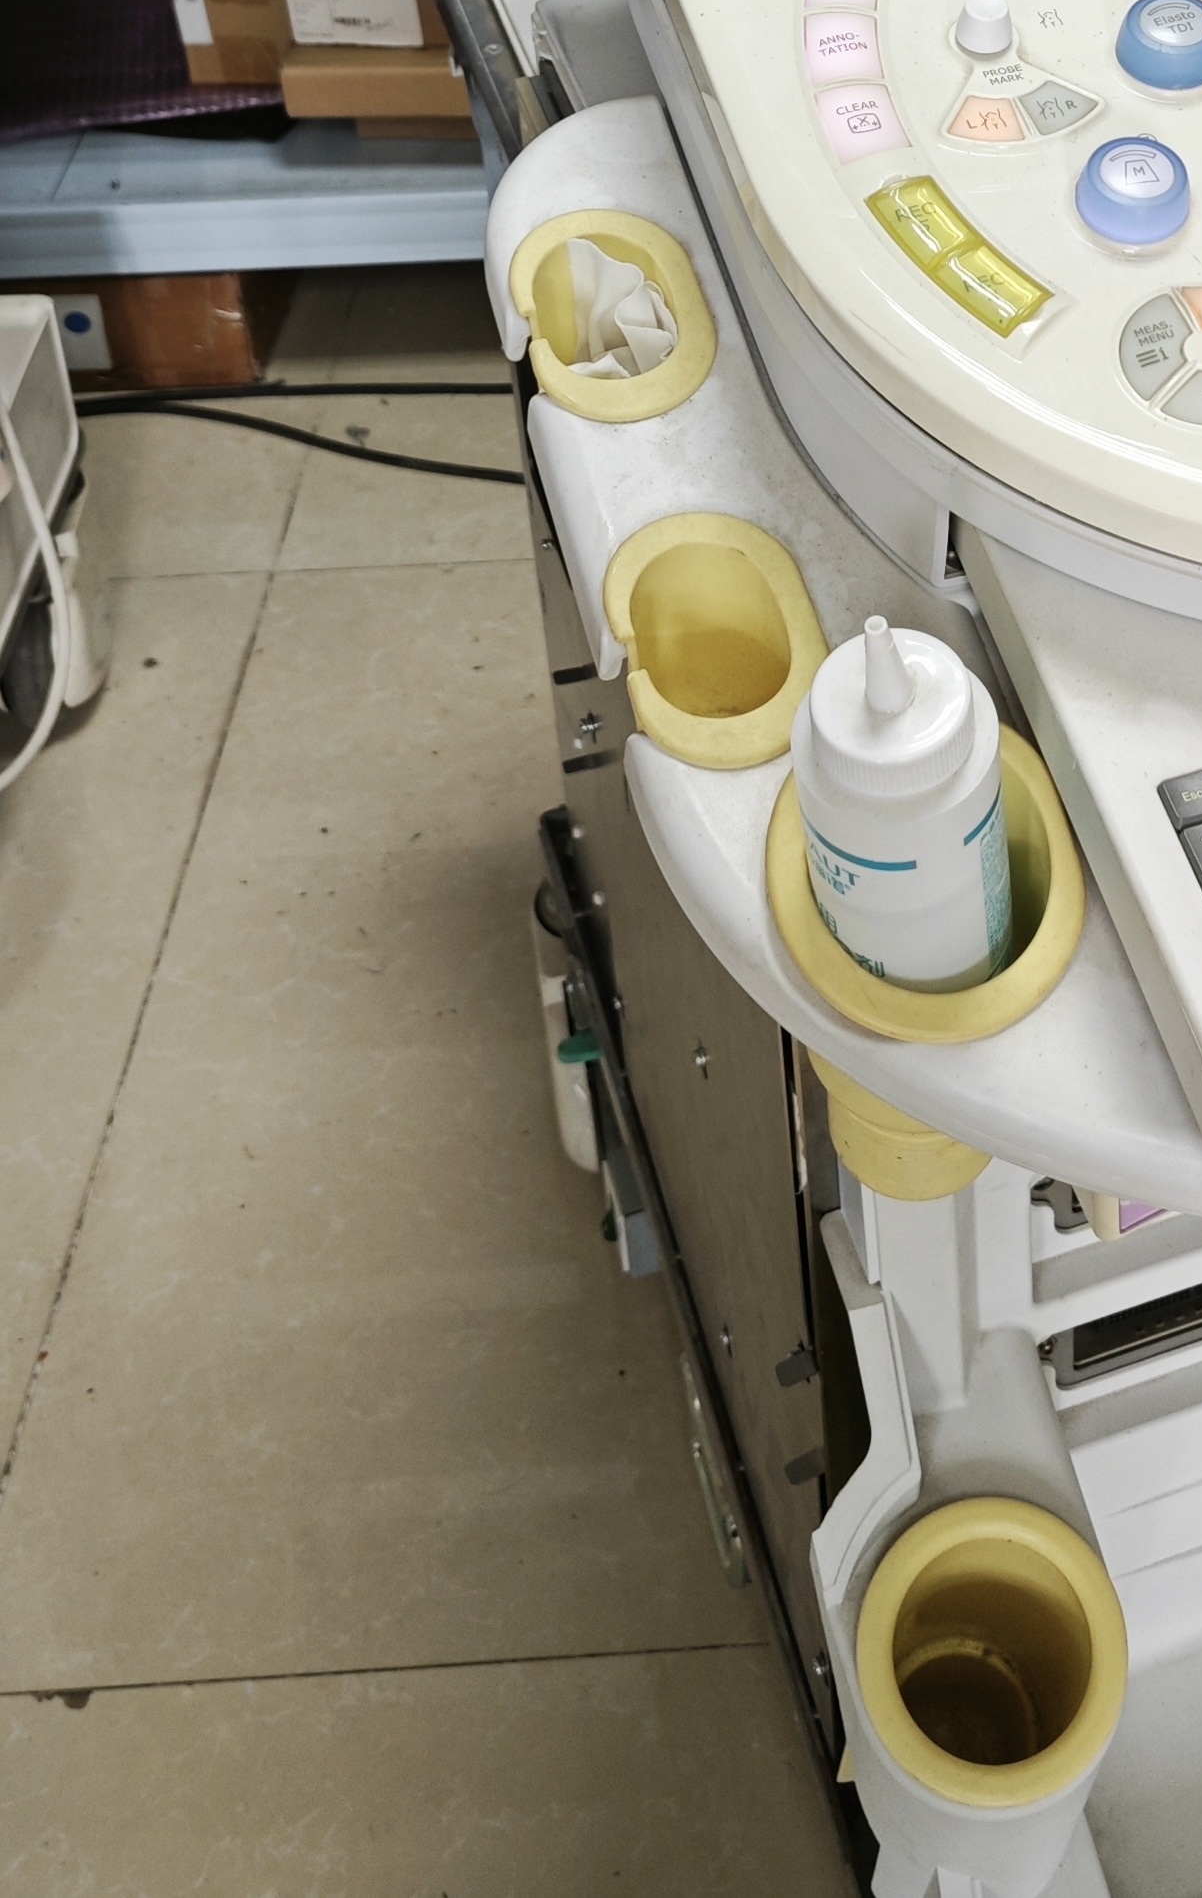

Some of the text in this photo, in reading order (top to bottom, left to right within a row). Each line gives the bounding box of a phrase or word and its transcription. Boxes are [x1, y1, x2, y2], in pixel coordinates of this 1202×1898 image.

[1153, 9, 1195, 28] Elasto
[1166, 20, 1194, 35] TDI
[819, 32, 860, 48] ANNO-
[818, 41, 868, 57] TATION
[982, 64, 1023, 79] PROBE
[989, 72, 1024, 86] MARK
[836, 100, 879, 116] CLEAR
[1133, 320, 1173, 339] MEAS.
[1138, 327, 1174, 346] MENU
